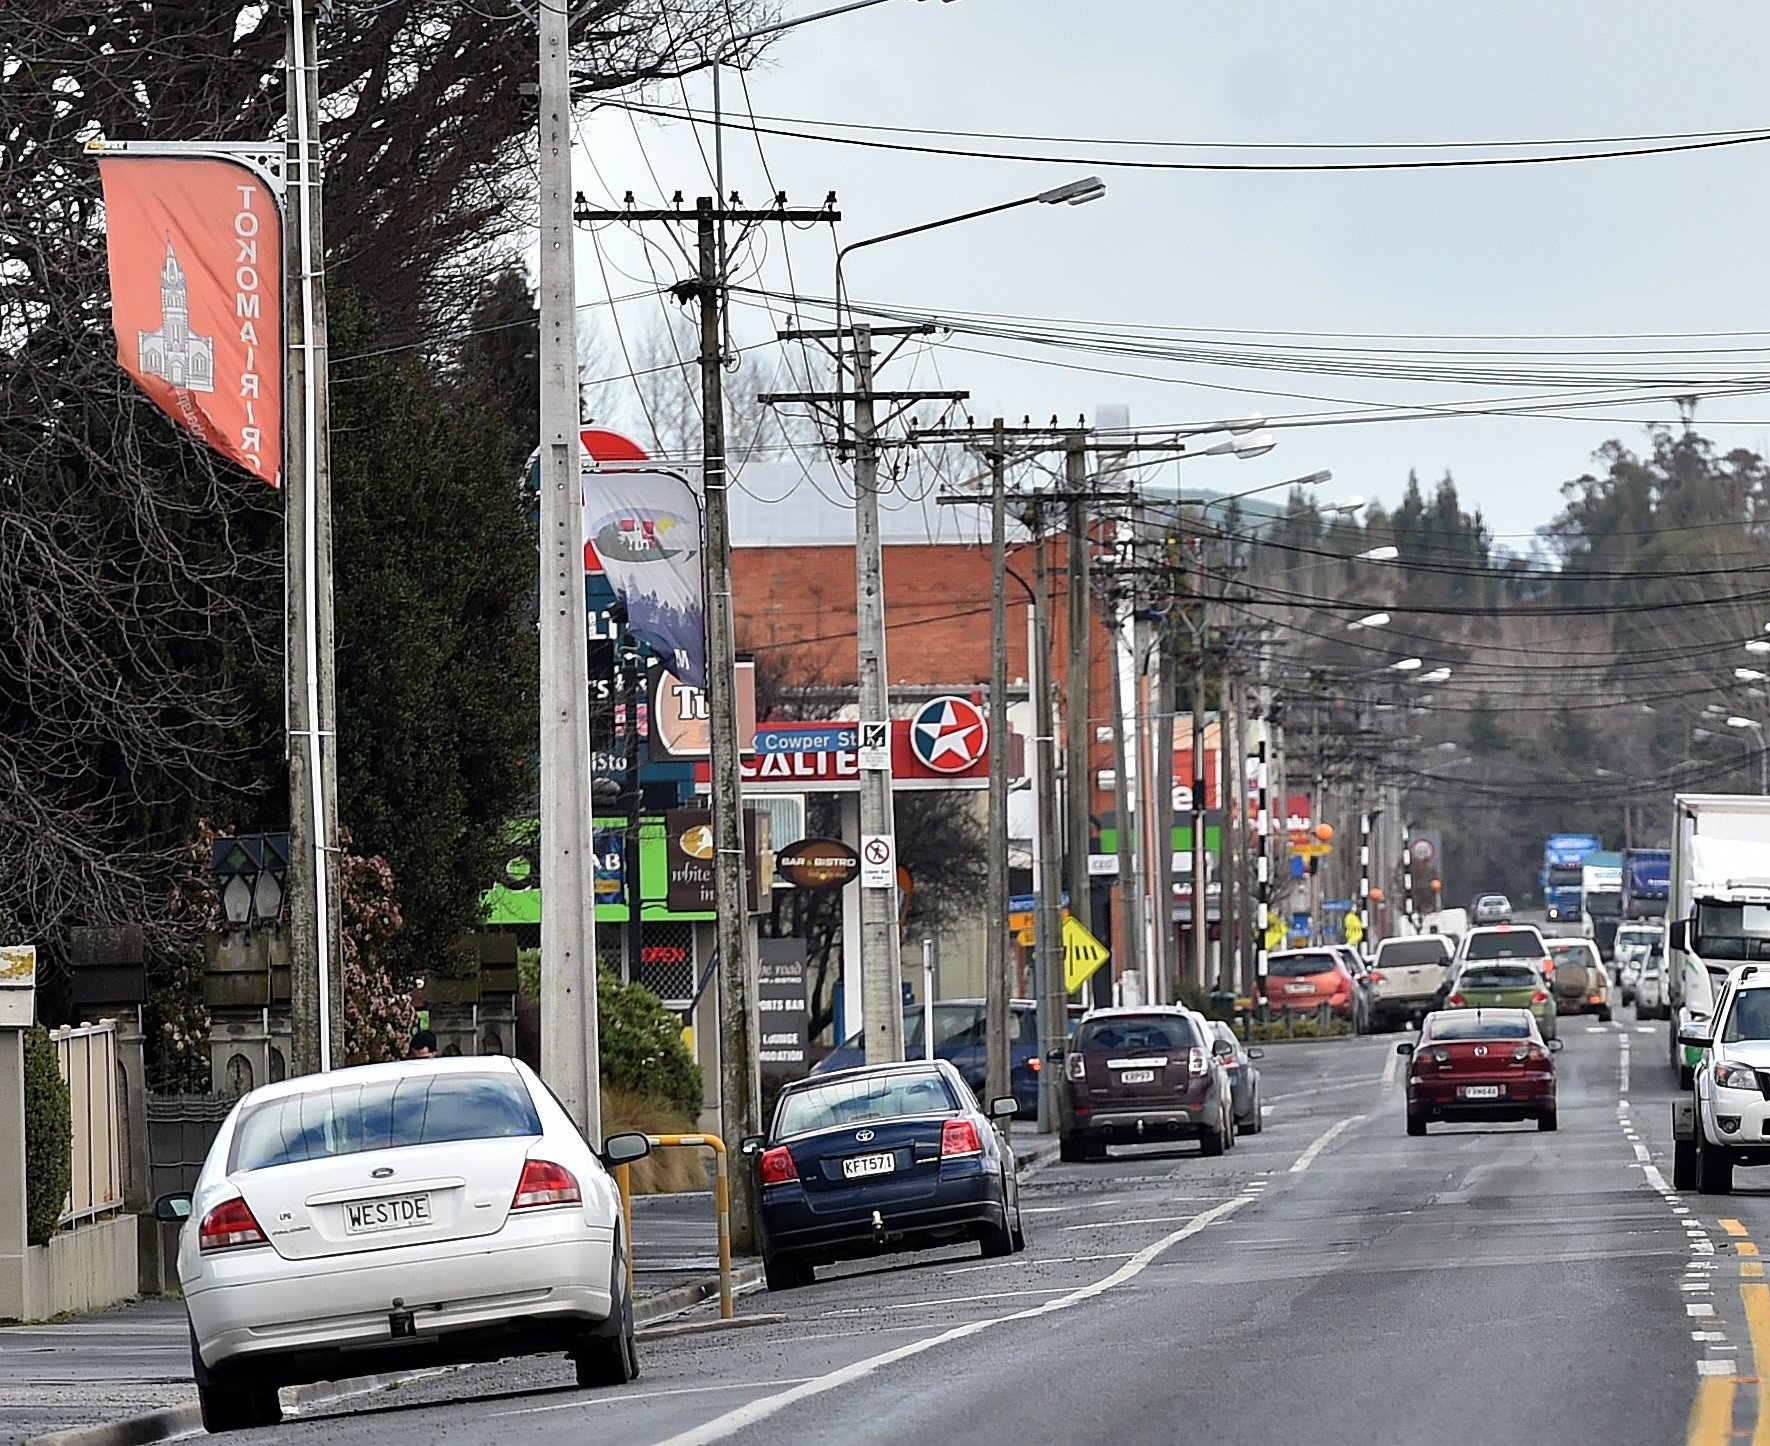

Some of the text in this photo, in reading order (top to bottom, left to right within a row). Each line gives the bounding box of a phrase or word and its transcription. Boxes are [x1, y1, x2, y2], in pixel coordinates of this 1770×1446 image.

[765, 731, 857, 751] Cowper St
[781, 857, 806, 867] BAR
[814, 857, 857, 868] BISTRO
[672, 861, 711, 885] white
[641, 946, 687, 963] OPEN
[845, 1156, 892, 1174] KFT571
[349, 1197, 428, 1227] WESTDE
